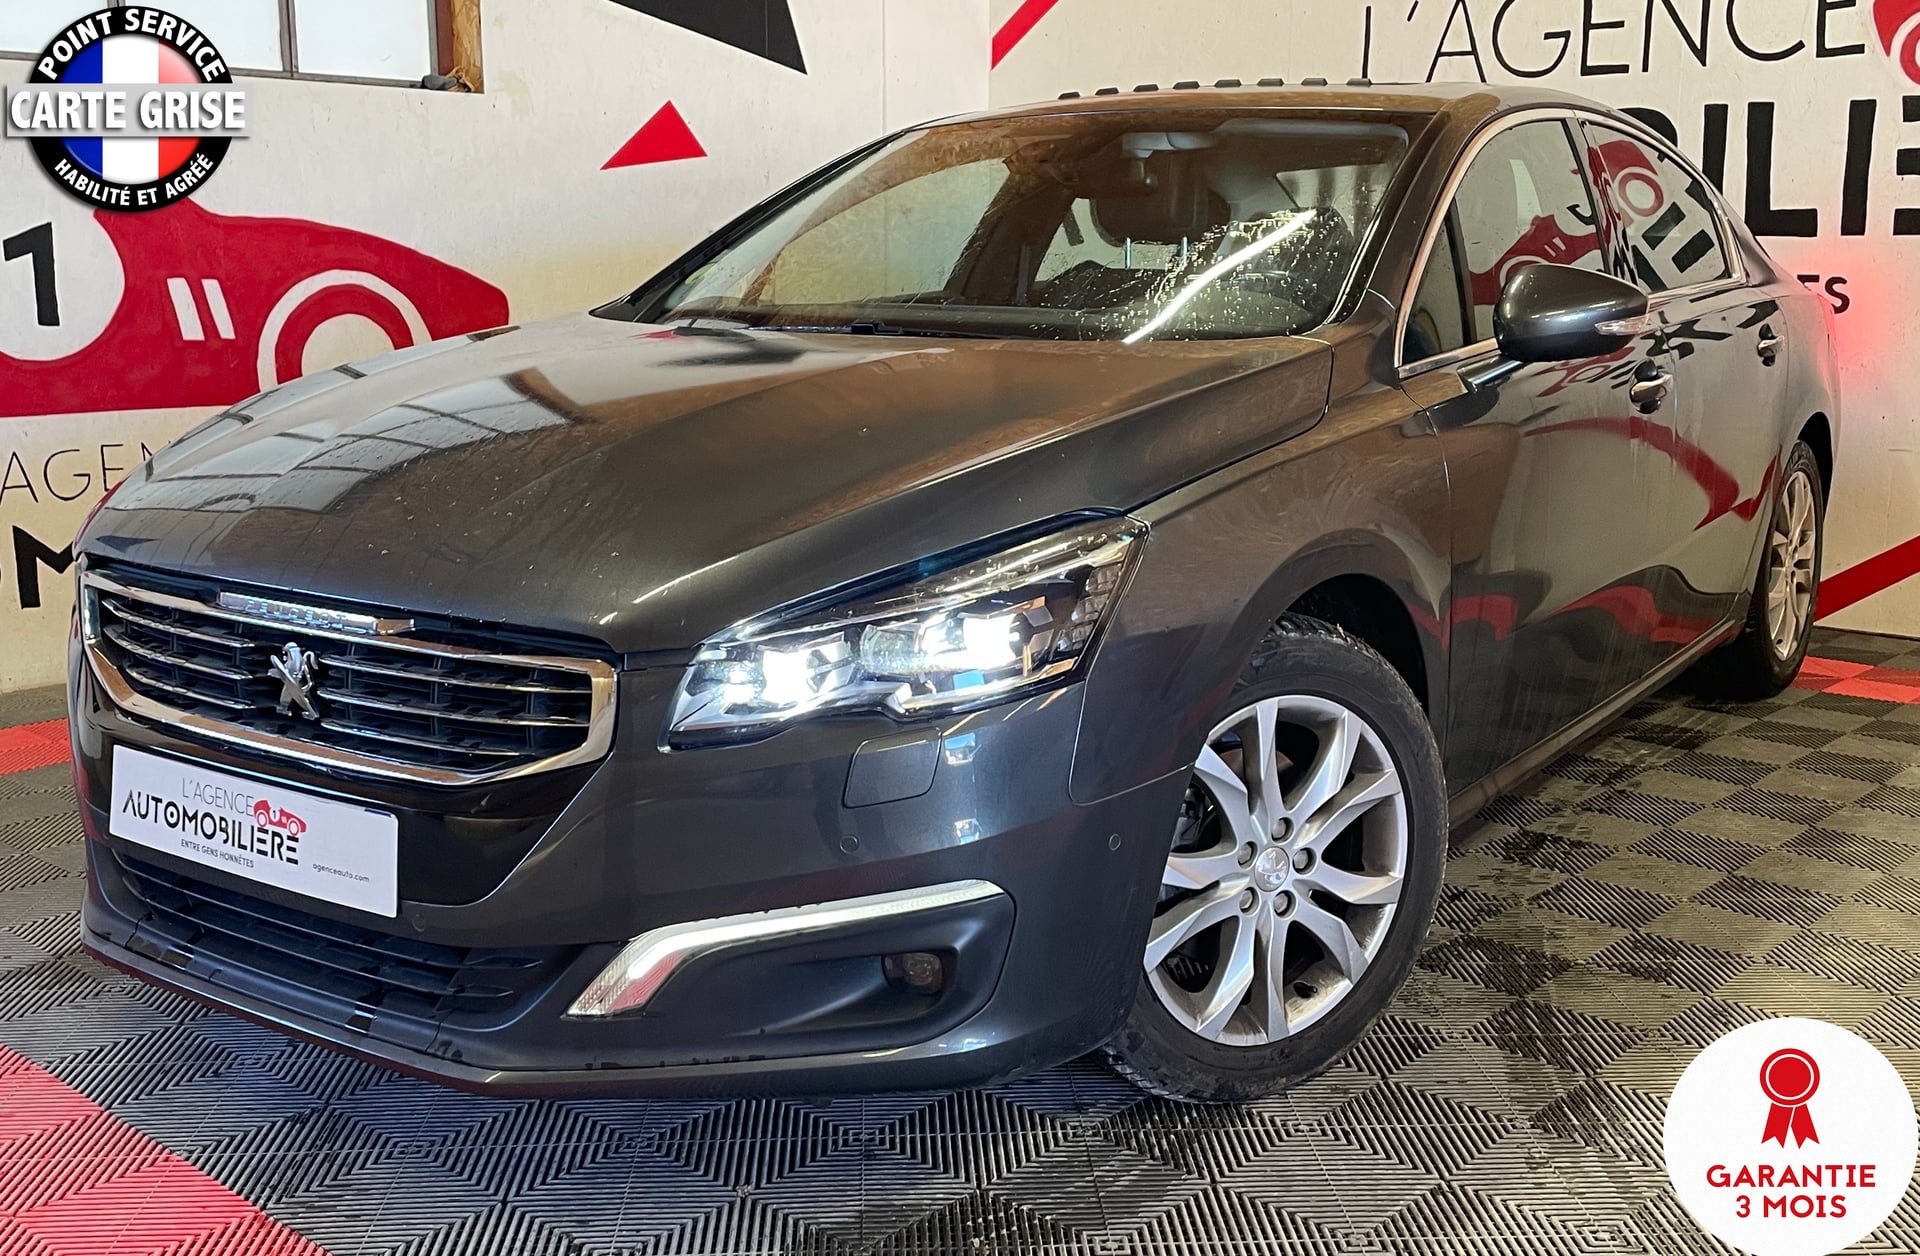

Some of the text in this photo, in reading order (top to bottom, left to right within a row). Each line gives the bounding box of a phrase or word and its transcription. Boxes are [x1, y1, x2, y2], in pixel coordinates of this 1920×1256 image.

[4, 221, 61, 327] 1
[245, 600, 347, 628] PEUGEOT
[182, 777, 255, 818] L'AGENCE
[180, 838, 201, 853] ENTRE
[202, 845, 218, 858] GENS
[312, 863, 370, 884] agenceauto.com
